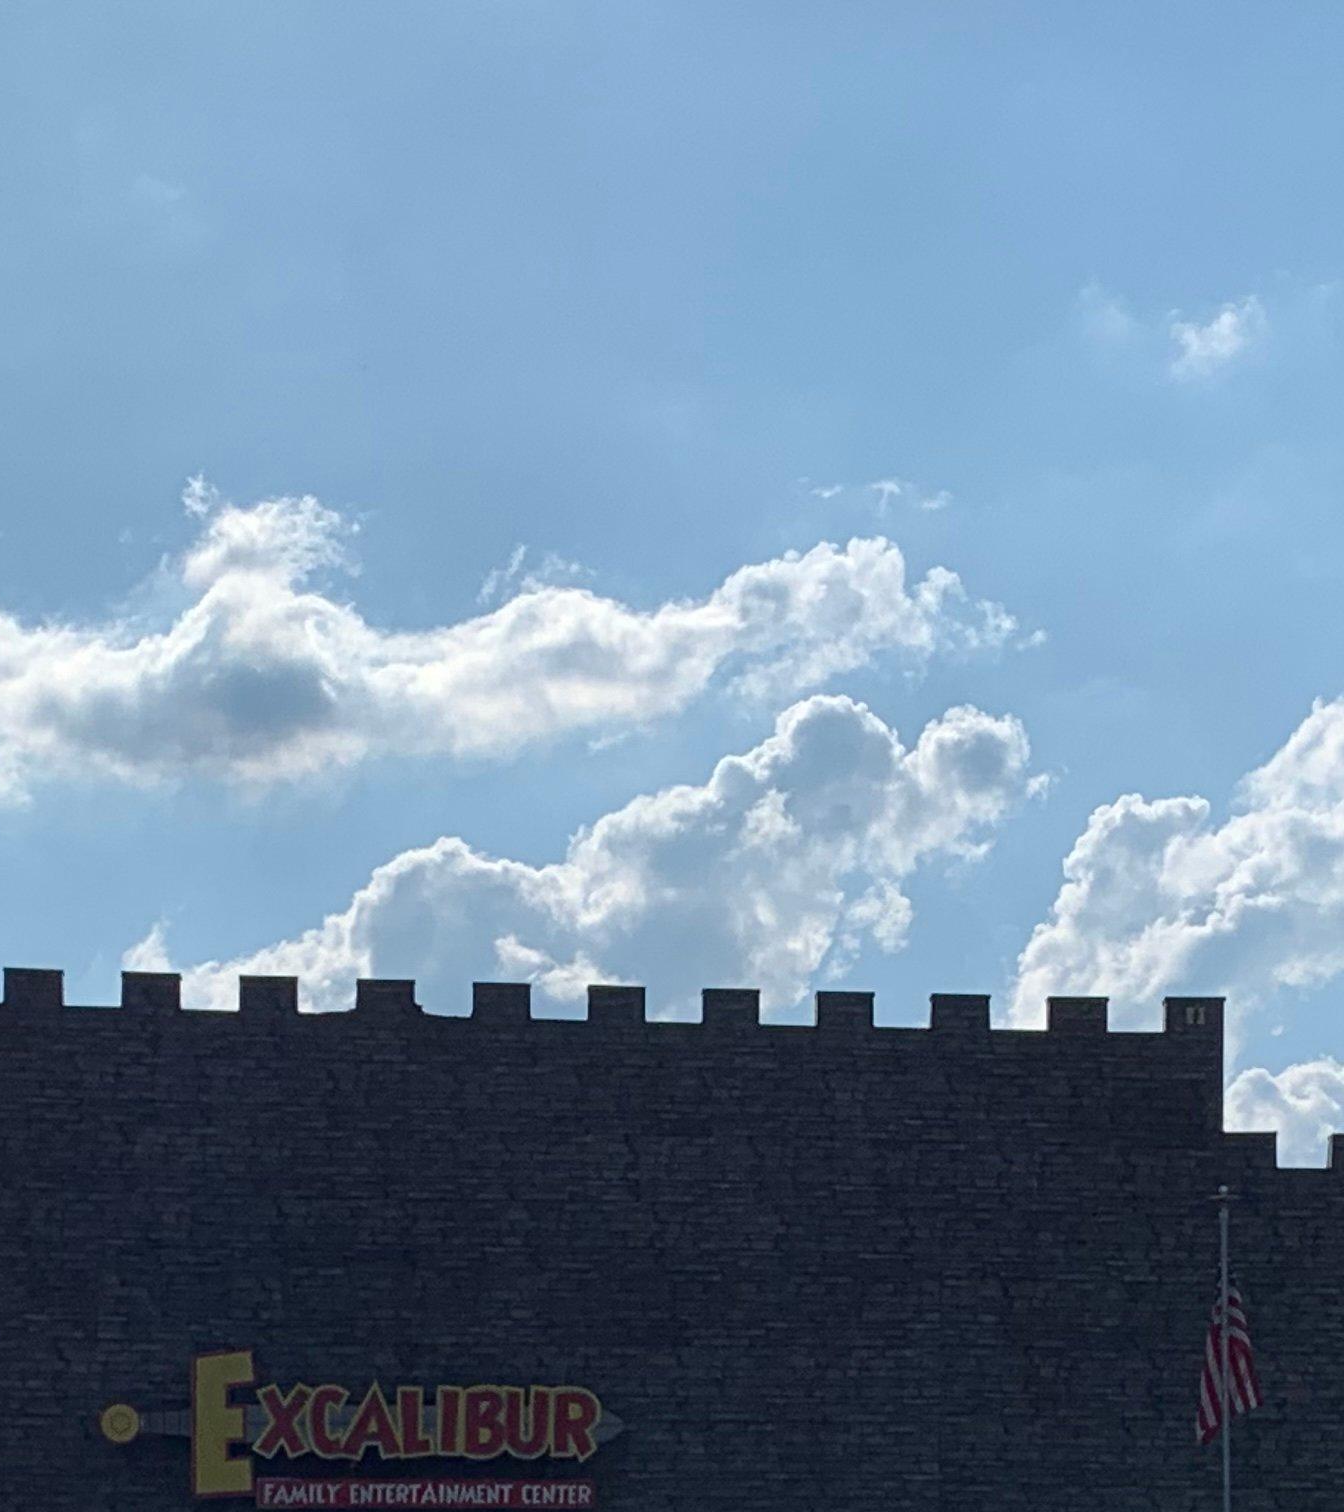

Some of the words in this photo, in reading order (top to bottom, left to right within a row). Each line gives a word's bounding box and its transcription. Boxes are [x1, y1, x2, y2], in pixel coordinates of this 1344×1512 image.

[191, 1350, 602, 1498] EXCALIBUR
[262, 1481, 341, 1505] FAMILY
[349, 1482, 514, 1505] ENTERTAINMENT
[520, 1483, 593, 1505] CENTER
